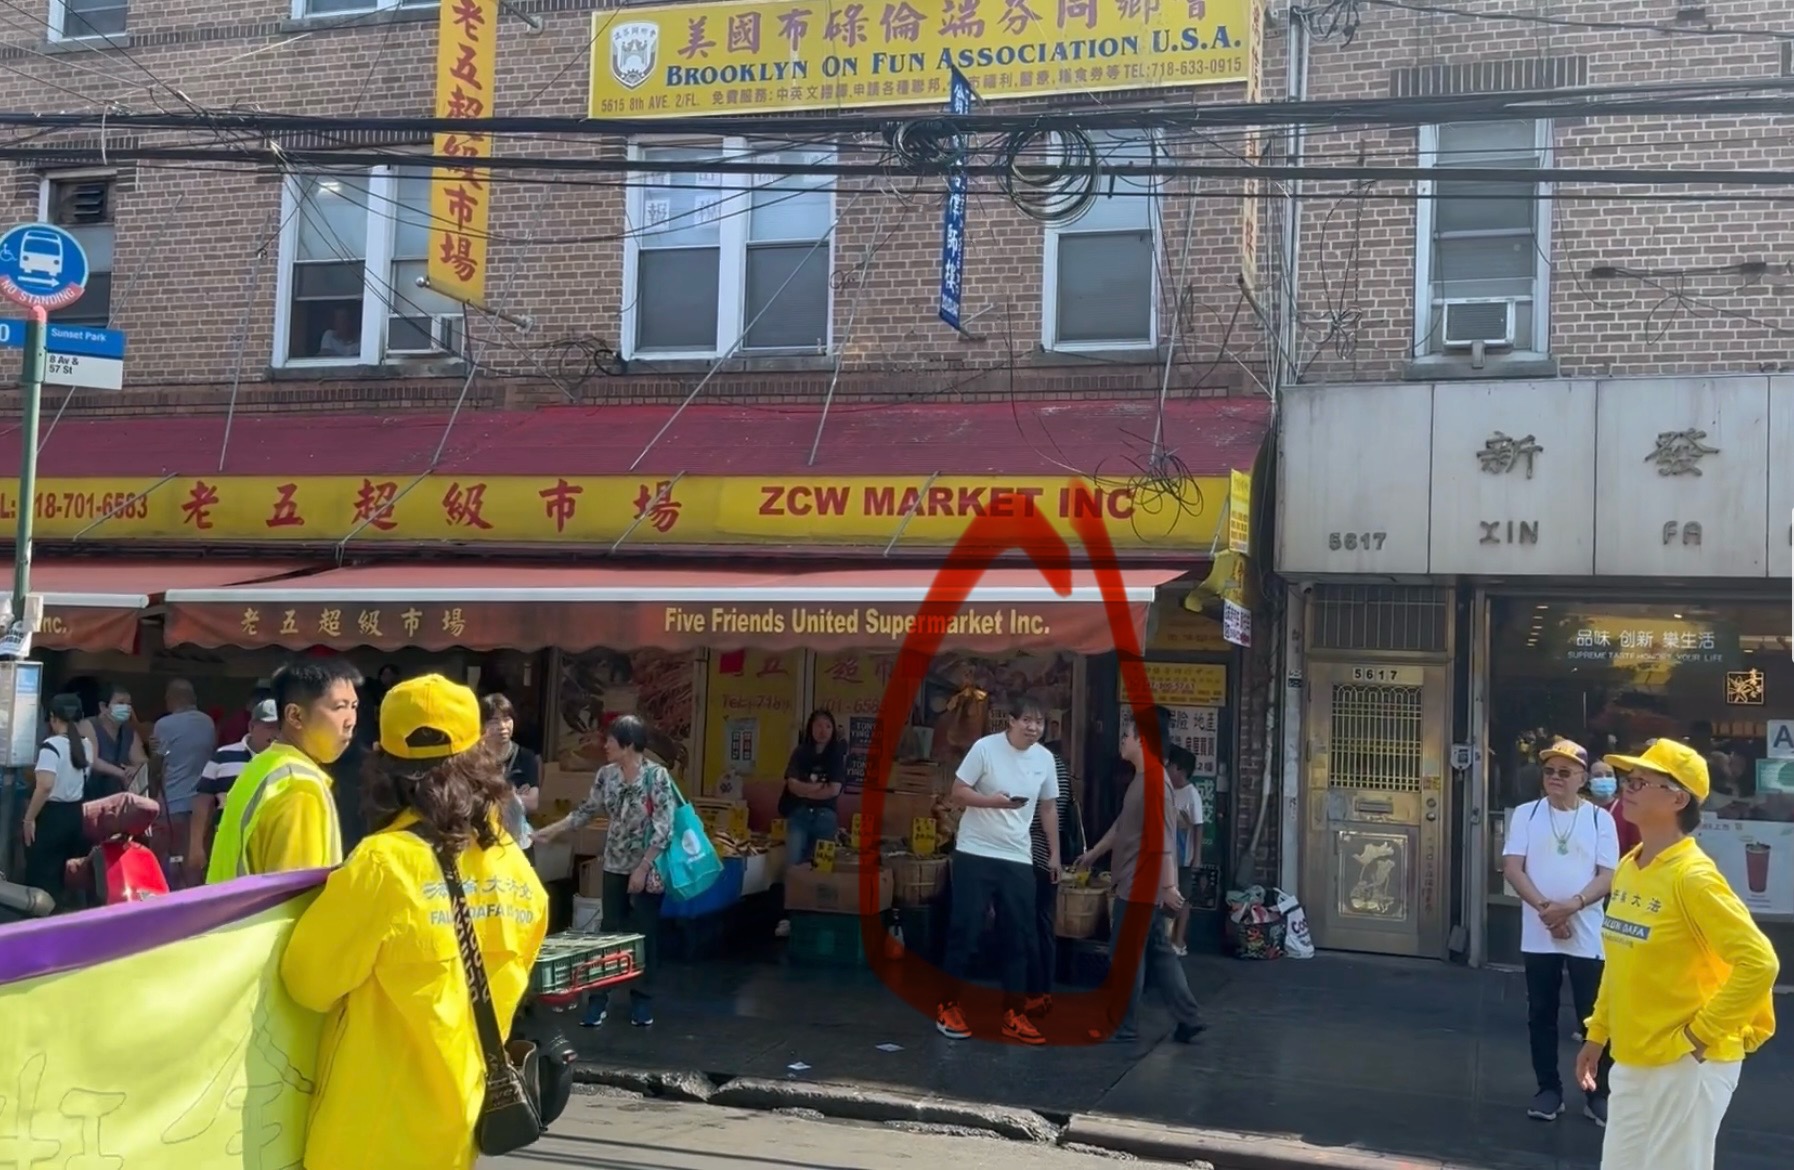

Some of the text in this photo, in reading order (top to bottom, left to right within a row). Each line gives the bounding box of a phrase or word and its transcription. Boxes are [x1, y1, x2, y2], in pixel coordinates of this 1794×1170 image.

[666, 25, 1242, 87] BROOKLYN ON FUN ASSOCIATION U.S.A.
[601, 98, 625, 113] 5615
[629, 97, 644, 110] 8th
[1124, 56, 1242, 79] TEL:718-633-0915
[440, 0, 484, 282] 老五超級市場
[1, 277, 75, 306] NO STANDING
[51, 327, 107, 342] Sunset Park
[49, 364, 73, 374] 57 St
[50, 355, 79, 365] 8 Av &
[35, 493, 148, 519] 18-701-6583
[181, 477, 683, 533] 老五超級市場
[759, 486, 1135, 519] ZCW MARKET INC
[1329, 533, 1387, 551] 5617
[1479, 521, 1702, 546] XIN FA
[42, 616, 68, 634] nc.
[240, 608, 467, 637] 老五超級市場
[665, 607, 1050, 640] Five Friends United Supermarket Inc.
[1576, 629, 1715, 649] 品味 创新 樂生活
[1704, 654, 1723, 663] LIFE
[1354, 667, 1399, 681] 5617
